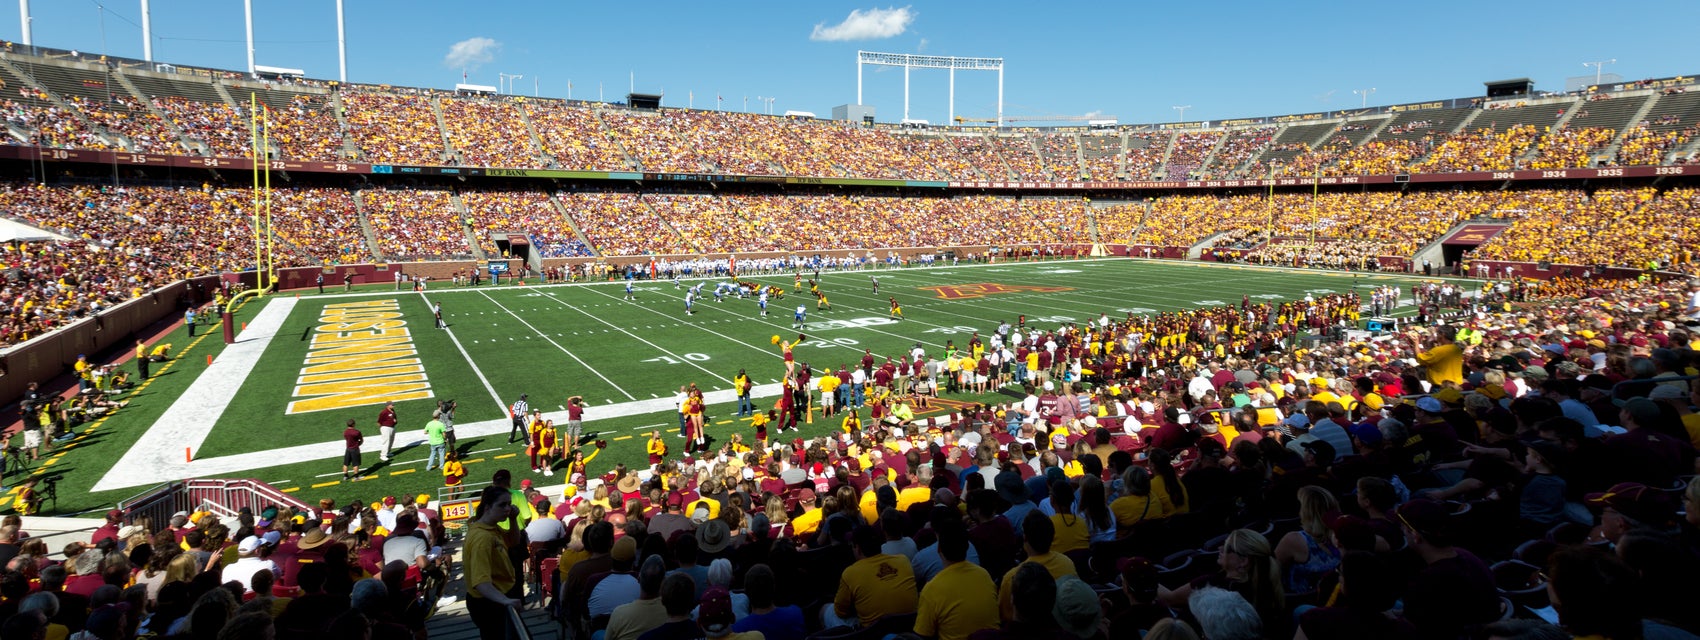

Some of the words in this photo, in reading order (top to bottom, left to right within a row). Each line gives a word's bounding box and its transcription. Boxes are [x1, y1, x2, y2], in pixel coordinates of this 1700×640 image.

[52, 150, 68, 160] 10
[131, 154, 146, 163] 15
[204, 158, 219, 167] 54
[272, 161, 285, 169] 72
[336, 163, 348, 171] 78
[489, 168, 504, 176] TCF
[1493, 171, 1515, 179] 1904
[1542, 170, 1567, 178] 1934
[1597, 168, 1623, 177] 1935
[1655, 166, 1683, 175] 1936
[806, 338, 859, 348] 20
[285, 299, 435, 415] MINNESOTA
[657, 352, 712, 365] 10
[446, 506, 466, 517] 145
